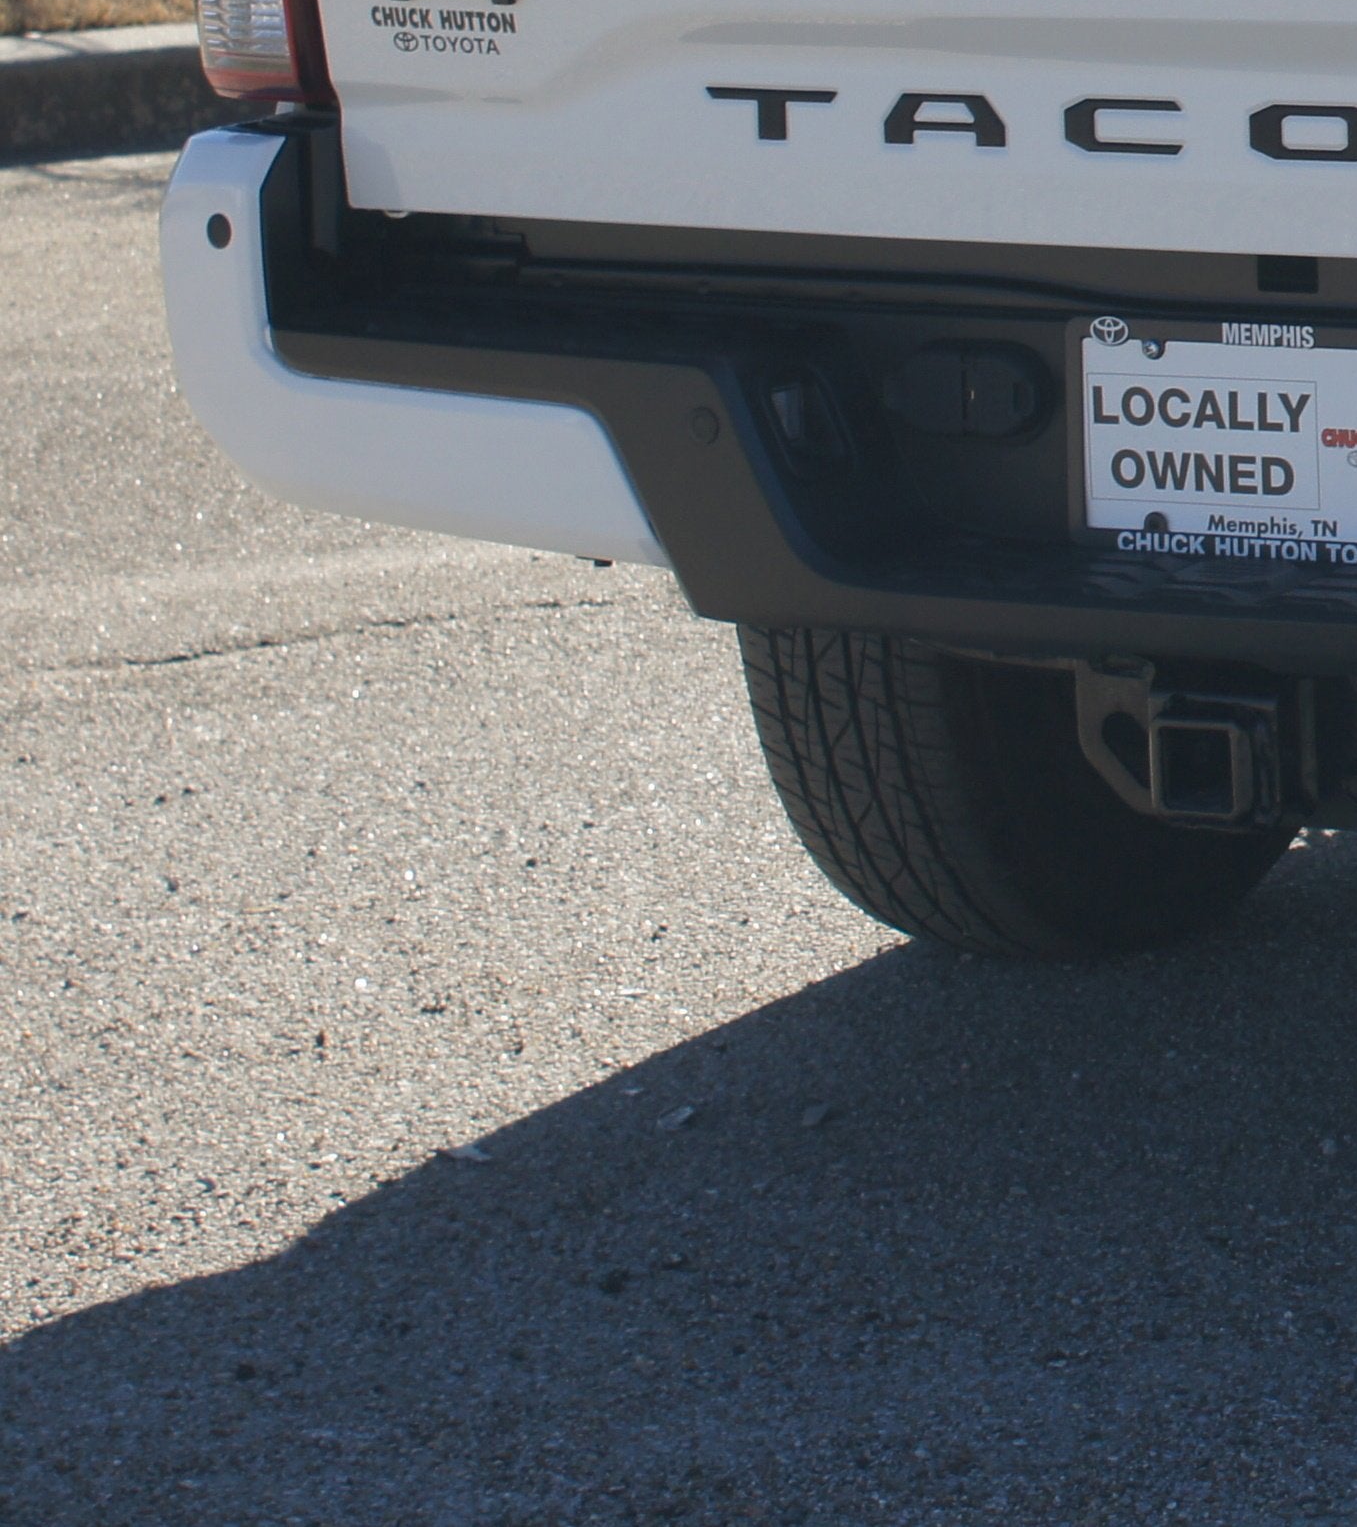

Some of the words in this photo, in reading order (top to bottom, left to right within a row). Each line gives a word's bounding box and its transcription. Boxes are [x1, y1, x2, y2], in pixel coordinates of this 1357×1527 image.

[371, 5, 433, 30] CHUCK
[439, 9, 516, 34] HUTTON
[421, 34, 500, 55] TOYOTA
[1221, 322, 1315, 348] MEMPHIS
[1091, 384, 1312, 433] LOCALLY
[1110, 448, 1295, 496] OWNED
[1207, 514, 1304, 540] Memphis,
[1310, 519, 1338, 538] TN
[1117, 530, 1206, 555] CHUCK
[1214, 536, 1318, 562] HUTTON
